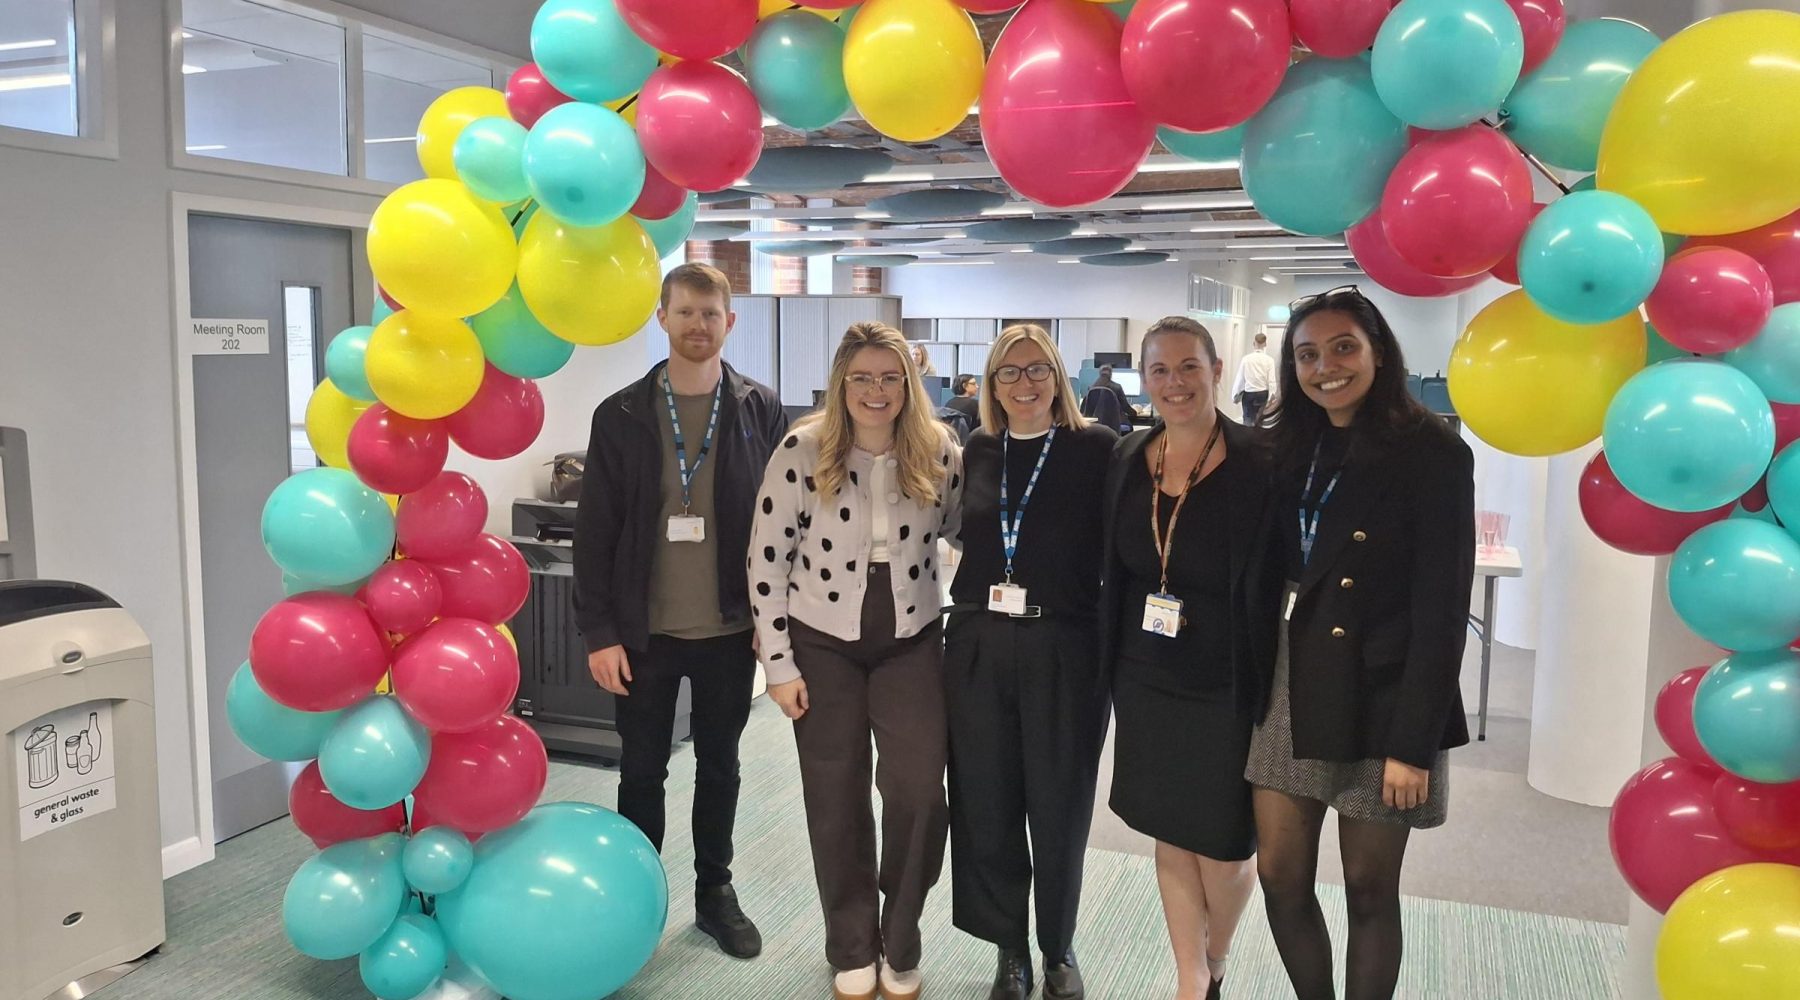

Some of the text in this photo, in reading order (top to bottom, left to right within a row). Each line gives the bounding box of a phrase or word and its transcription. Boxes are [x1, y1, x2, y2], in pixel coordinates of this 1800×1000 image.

[193, 323, 266, 338] Meeting Room
[222, 339, 240, 350] 202
[34, 788, 100, 819] general waste
[50, 806, 84, 824] & glass
